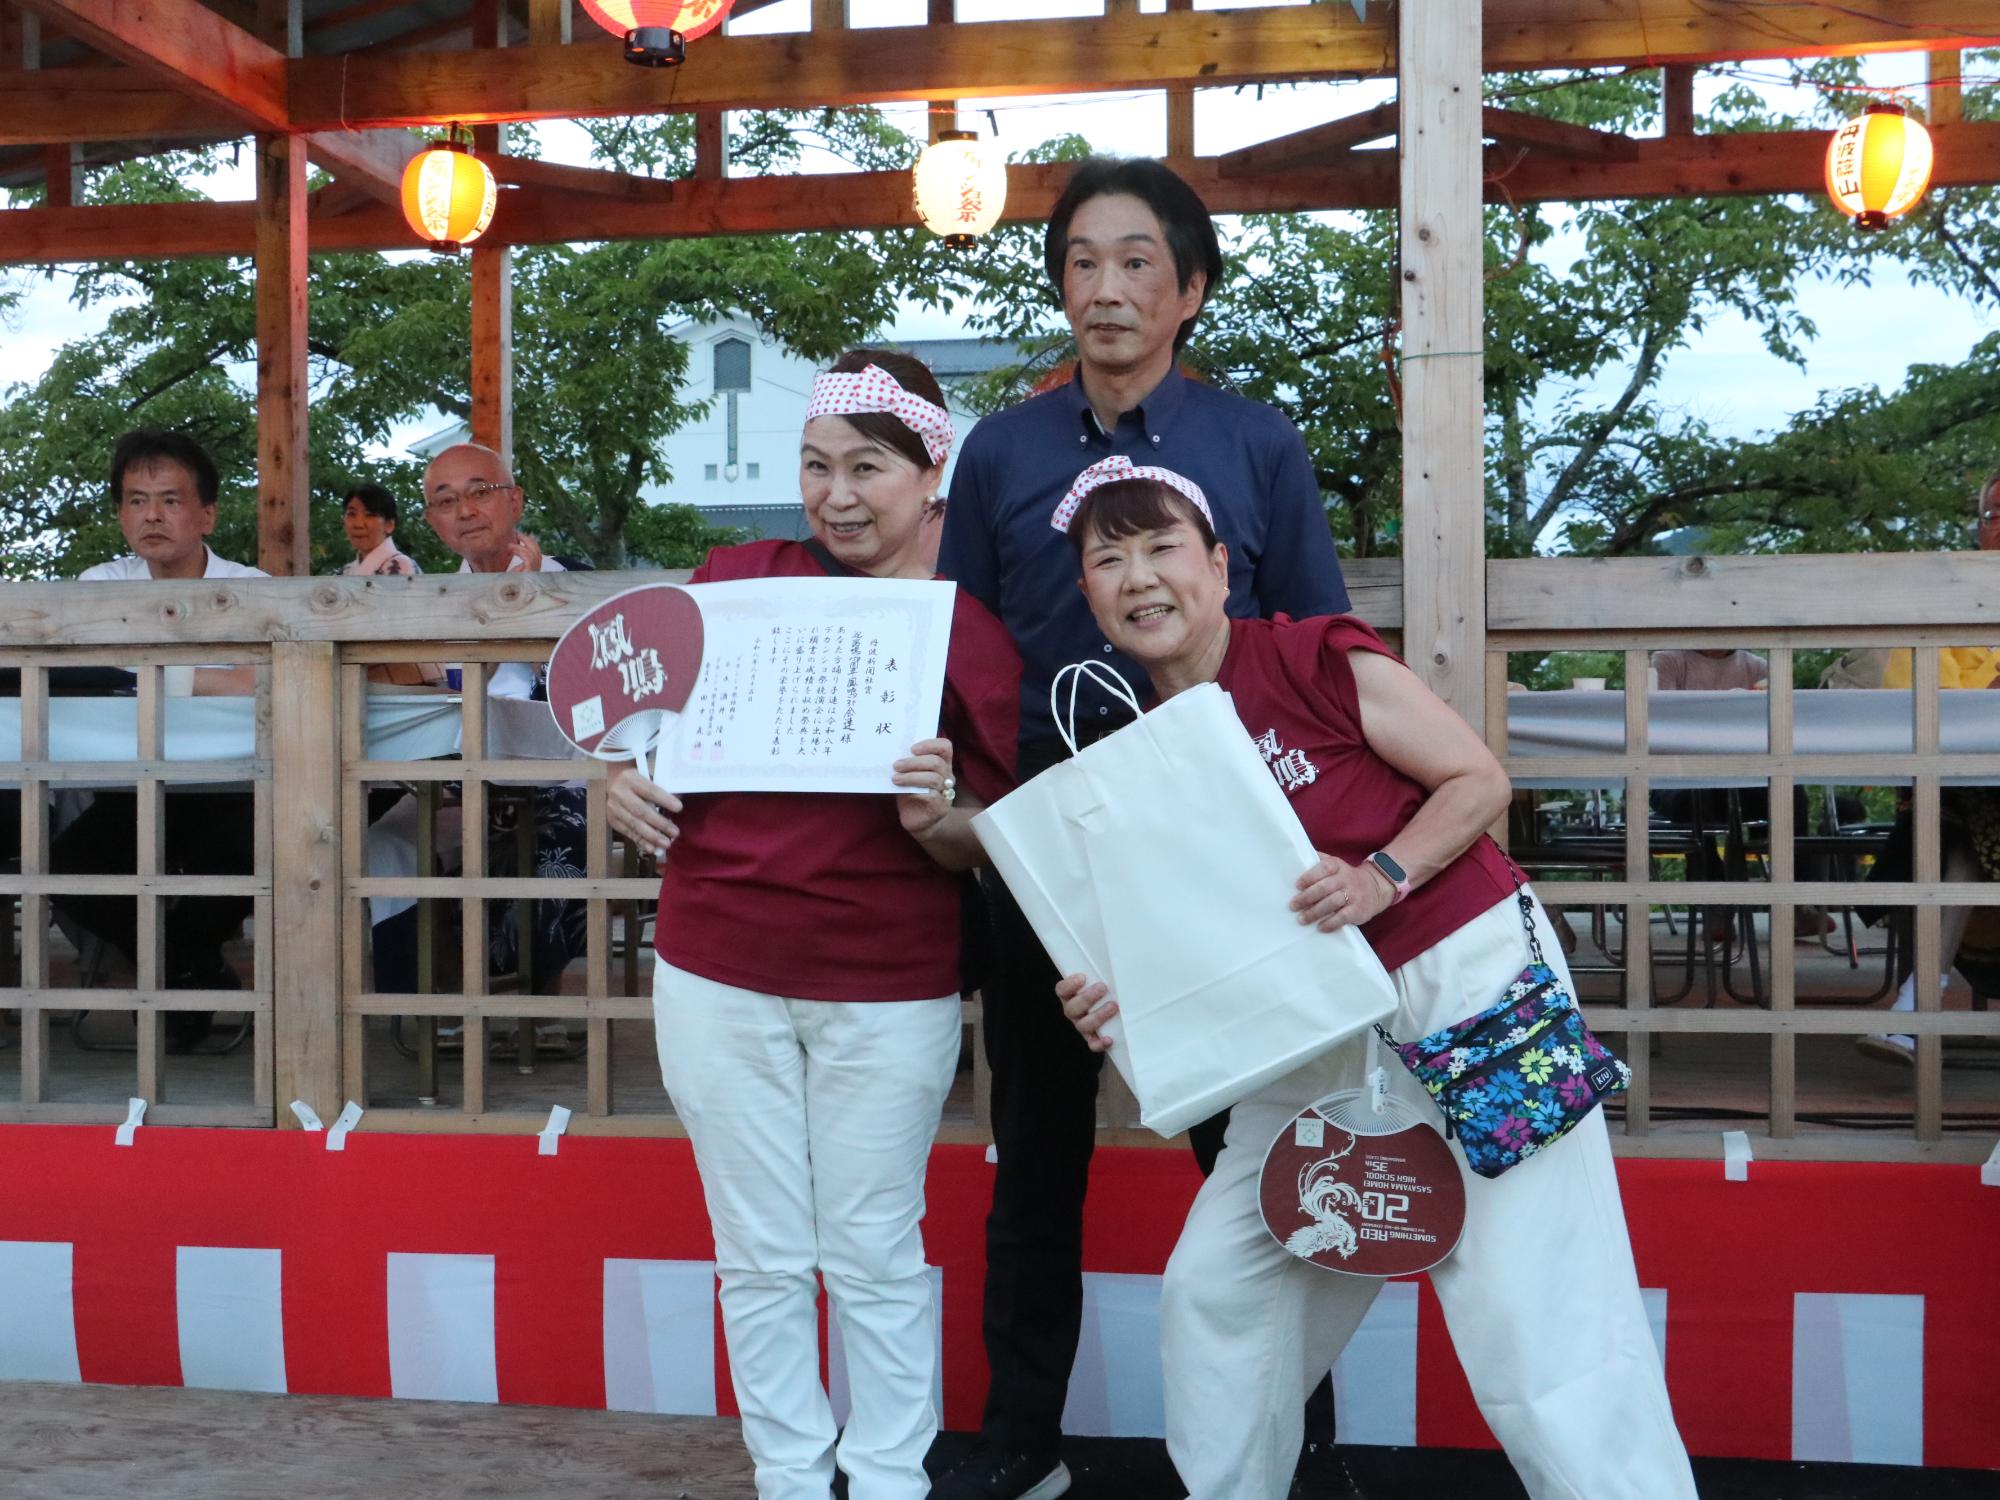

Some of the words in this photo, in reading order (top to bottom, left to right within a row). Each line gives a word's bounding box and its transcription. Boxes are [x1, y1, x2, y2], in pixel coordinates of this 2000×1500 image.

[875, 657, 898, 735] 表彰状
[1364, 1172, 1395, 1181] SCHOOL
[1397, 1175, 1416, 1183] HIGH
[1363, 1180, 1389, 1189] HOMEI
[1391, 1183, 1432, 1194] SASAYAMA
[1361, 1191, 1409, 1223] 20
[1360, 1227, 1388, 1242] RED
[1389, 1231, 1437, 1243] SOMETHING
